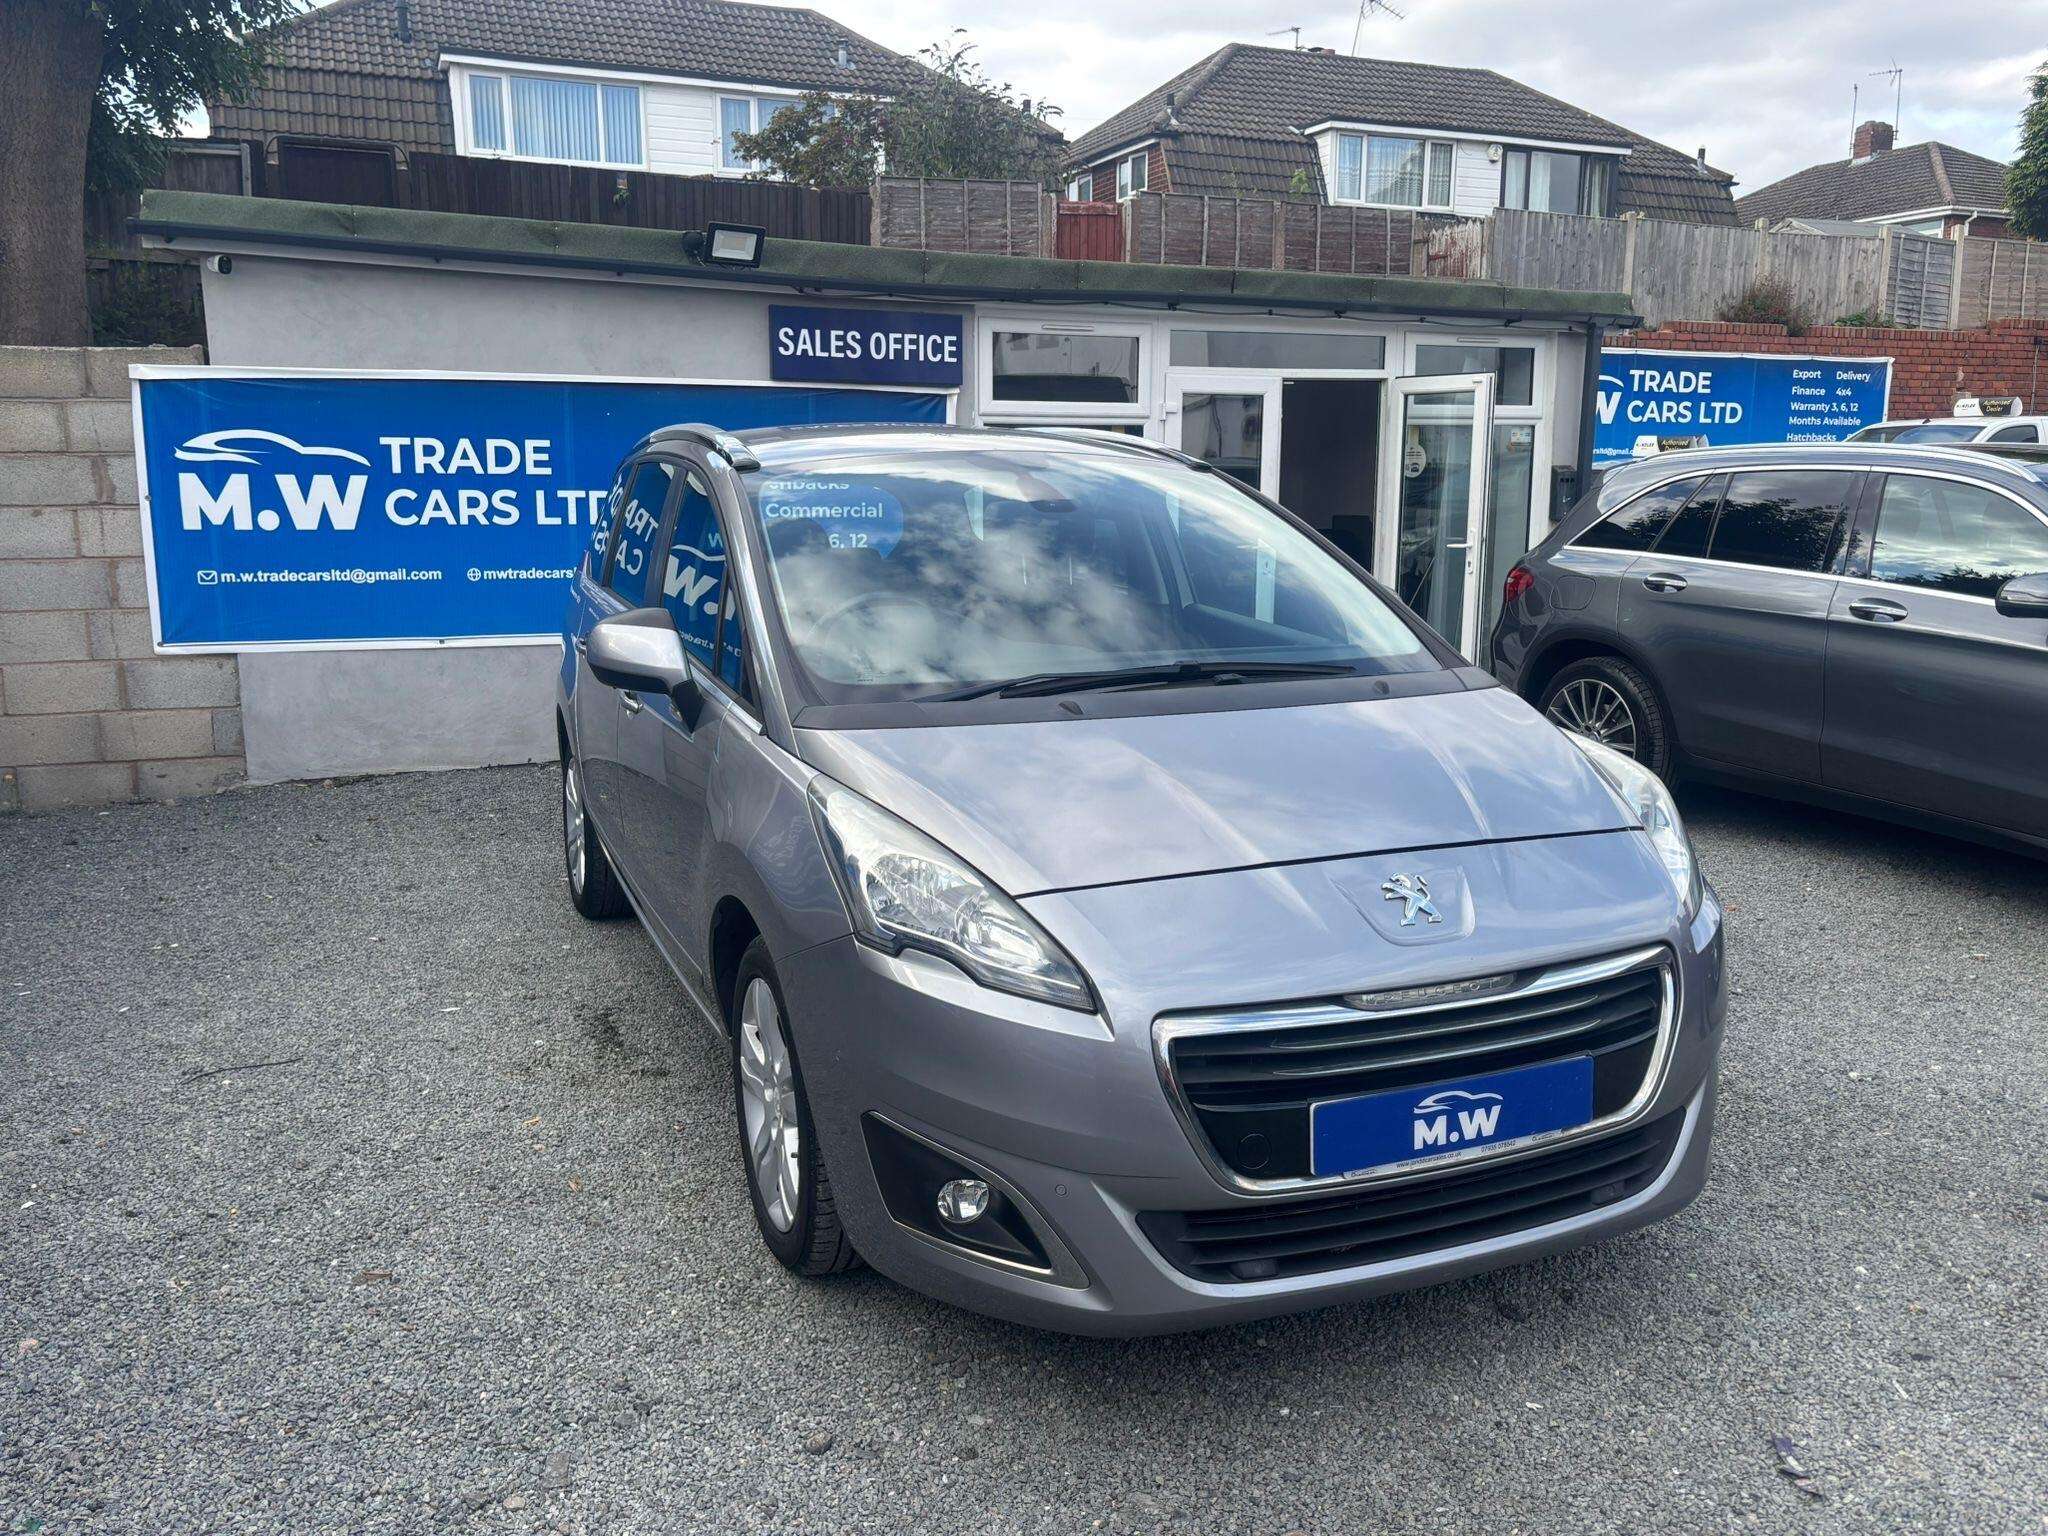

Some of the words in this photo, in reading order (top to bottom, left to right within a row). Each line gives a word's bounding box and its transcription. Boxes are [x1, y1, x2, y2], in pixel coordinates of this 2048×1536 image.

[778, 327, 861, 359] SALES
[869, 332, 958, 363] OFFICE
[1629, 369, 1712, 394] TRADE
[1793, 369, 1822, 380] Export
[1836, 371, 1871, 382] Delivery
[1792, 385, 1826, 396] Finance
[1836, 387, 1852, 396] 4x4
[1627, 400, 1693, 423] CARS
[1700, 402, 1743, 424] LTD
[1791, 402, 1830, 413] Warranty
[1831, 403, 1839, 412] 3,
[1841, 403, 1849, 412] 6,
[1851, 403, 1859, 411] 12
[1789, 416, 1821, 426] Months
[1822, 416, 1861, 426] Available
[1786, 432, 1837, 442] Hatchbacks
[379, 436, 552, 476] TRADE
[178, 472, 369, 531] M.W
[385, 488, 521, 526] CARS
[765, 502, 883, 518] Commercial
[849, 533, 868, 548] 12
[220, 568, 442, 585] m.w.tradecarsltd@gmail.com
[1414, 1104, 1502, 1151] M.W
